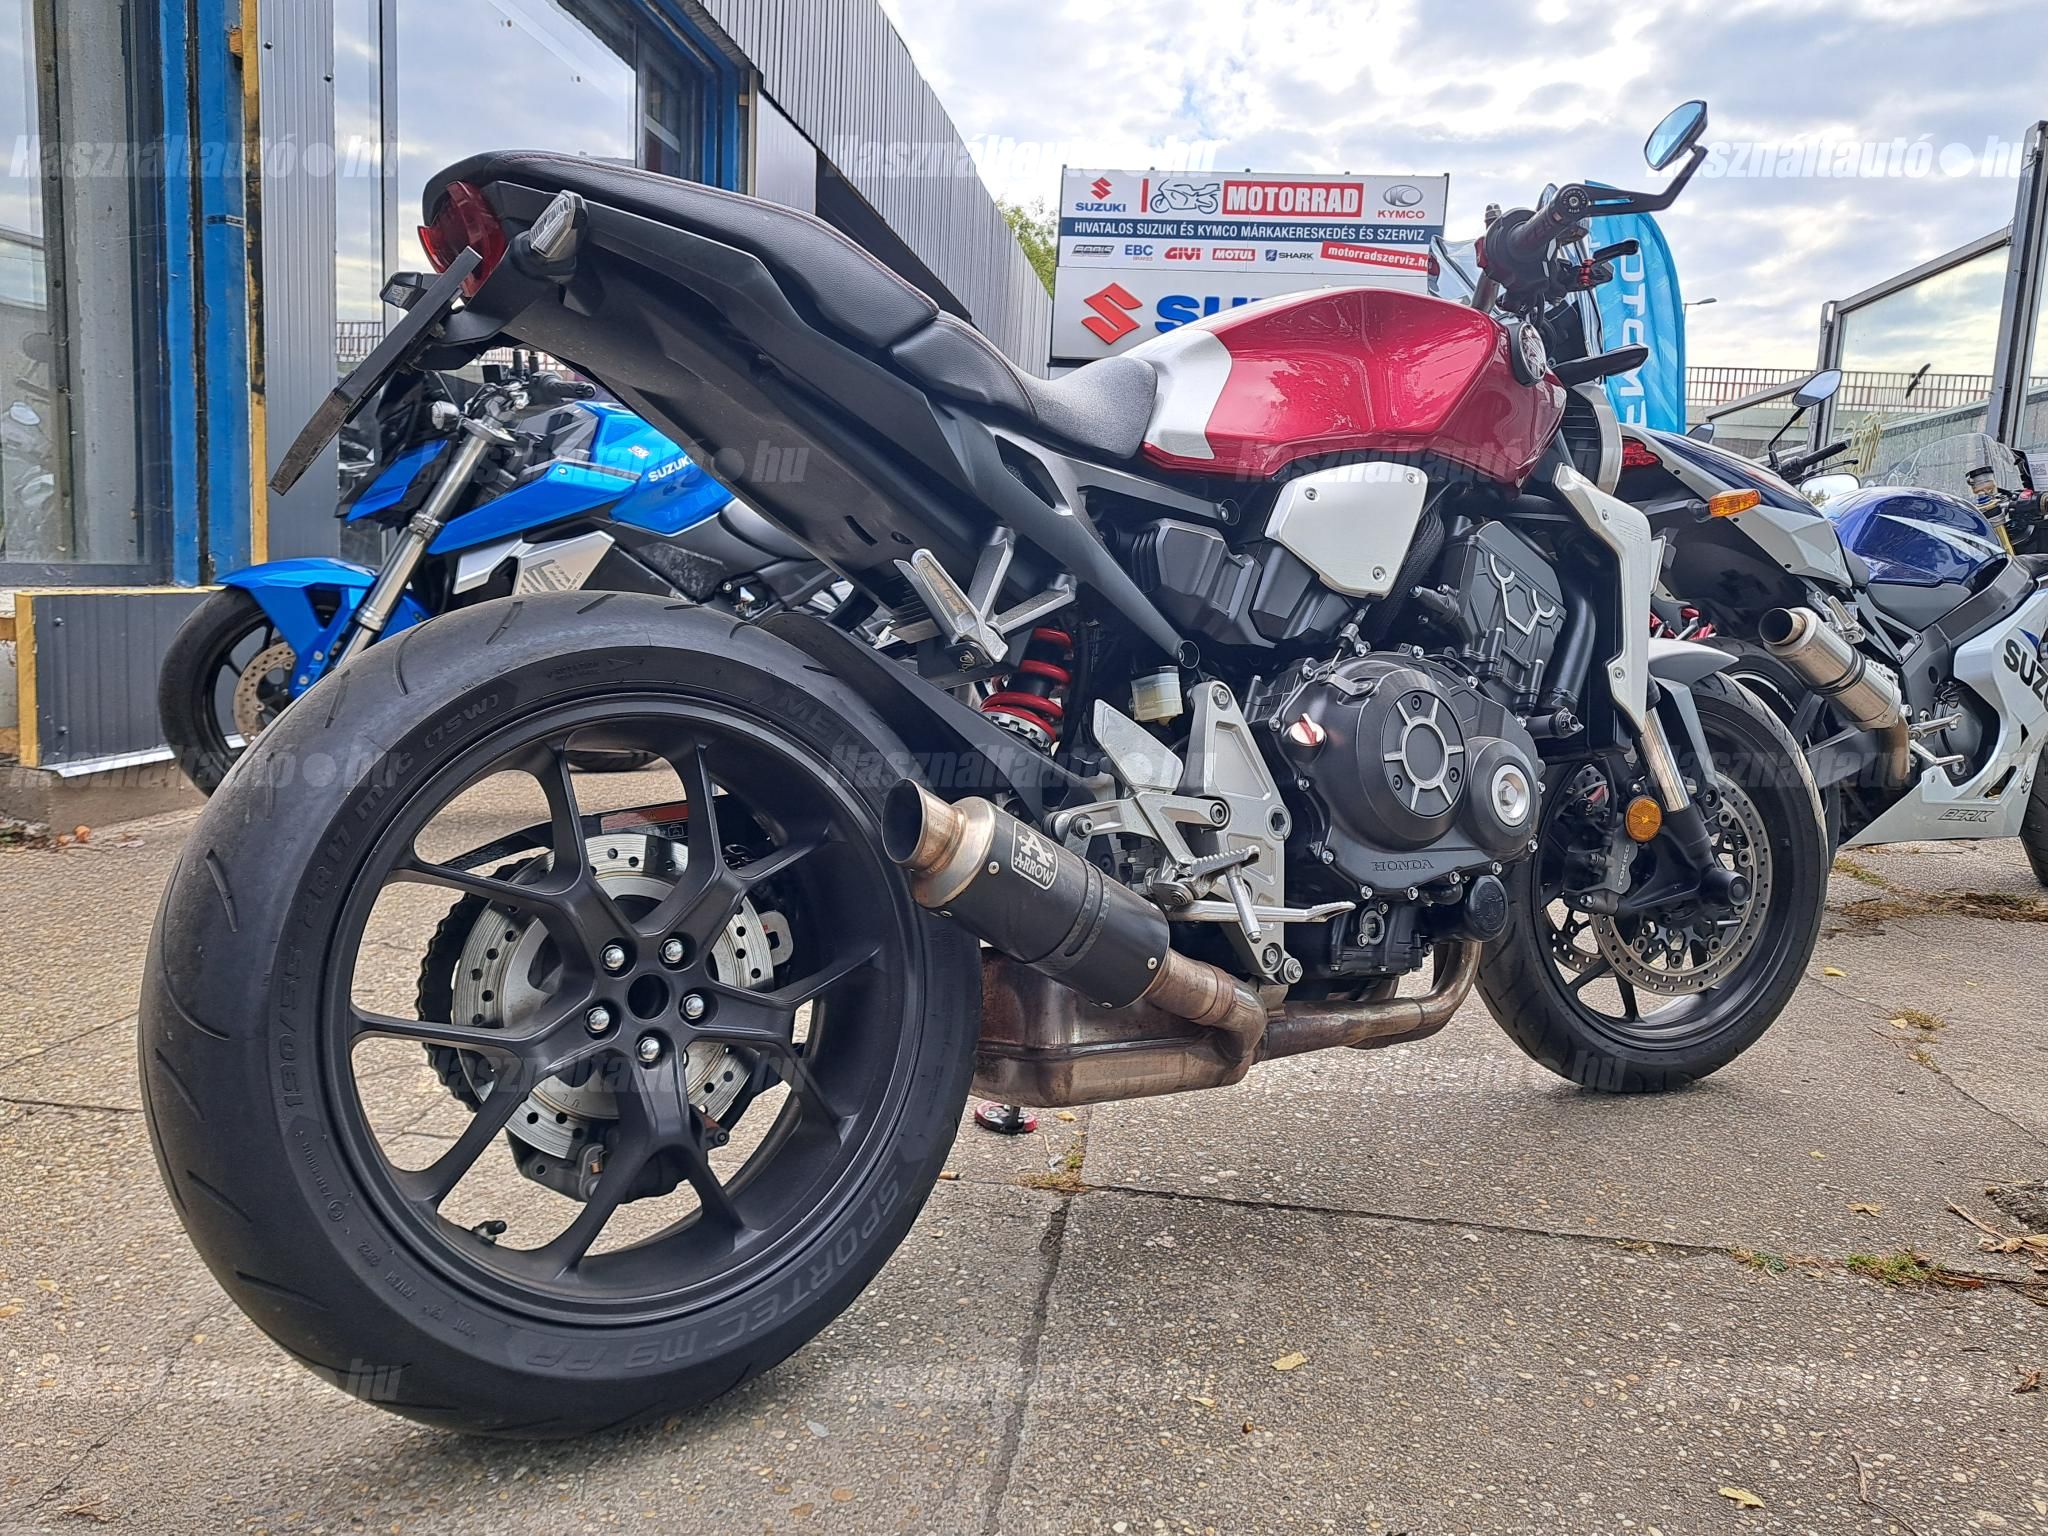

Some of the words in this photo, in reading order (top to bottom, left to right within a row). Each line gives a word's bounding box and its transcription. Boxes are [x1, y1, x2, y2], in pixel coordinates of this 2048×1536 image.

[1226, 185, 1359, 213] MOTORRAD
[1075, 202, 1126, 213] SUZUKI
[1377, 210, 1425, 219] KYMCO
[1074, 222, 1134, 235] HIVATALOS
[1136, 223, 1177, 236] SUZUKI
[1180, 222, 1195, 236] ÉS
[1197, 225, 1237, 237] KYMCO
[1241, 224, 1356, 240] MÁRKAKERESKEDÉS
[1359, 225, 1374, 240] ÉS
[1377, 228, 1425, 241] SZERVIZ
[1124, 244, 1154, 256] EBC
[1213, 249, 1254, 260] MOTUL
[1278, 252, 1314, 260] SHARK
[647, 454, 693, 482] SUZUK
[1014, 852, 1053, 885] ARROW
[1371, 859, 1434, 872] HONDA
[1617, 844, 1630, 887] TOKICO
[716, 1164, 900, 1347] SPORTEC
